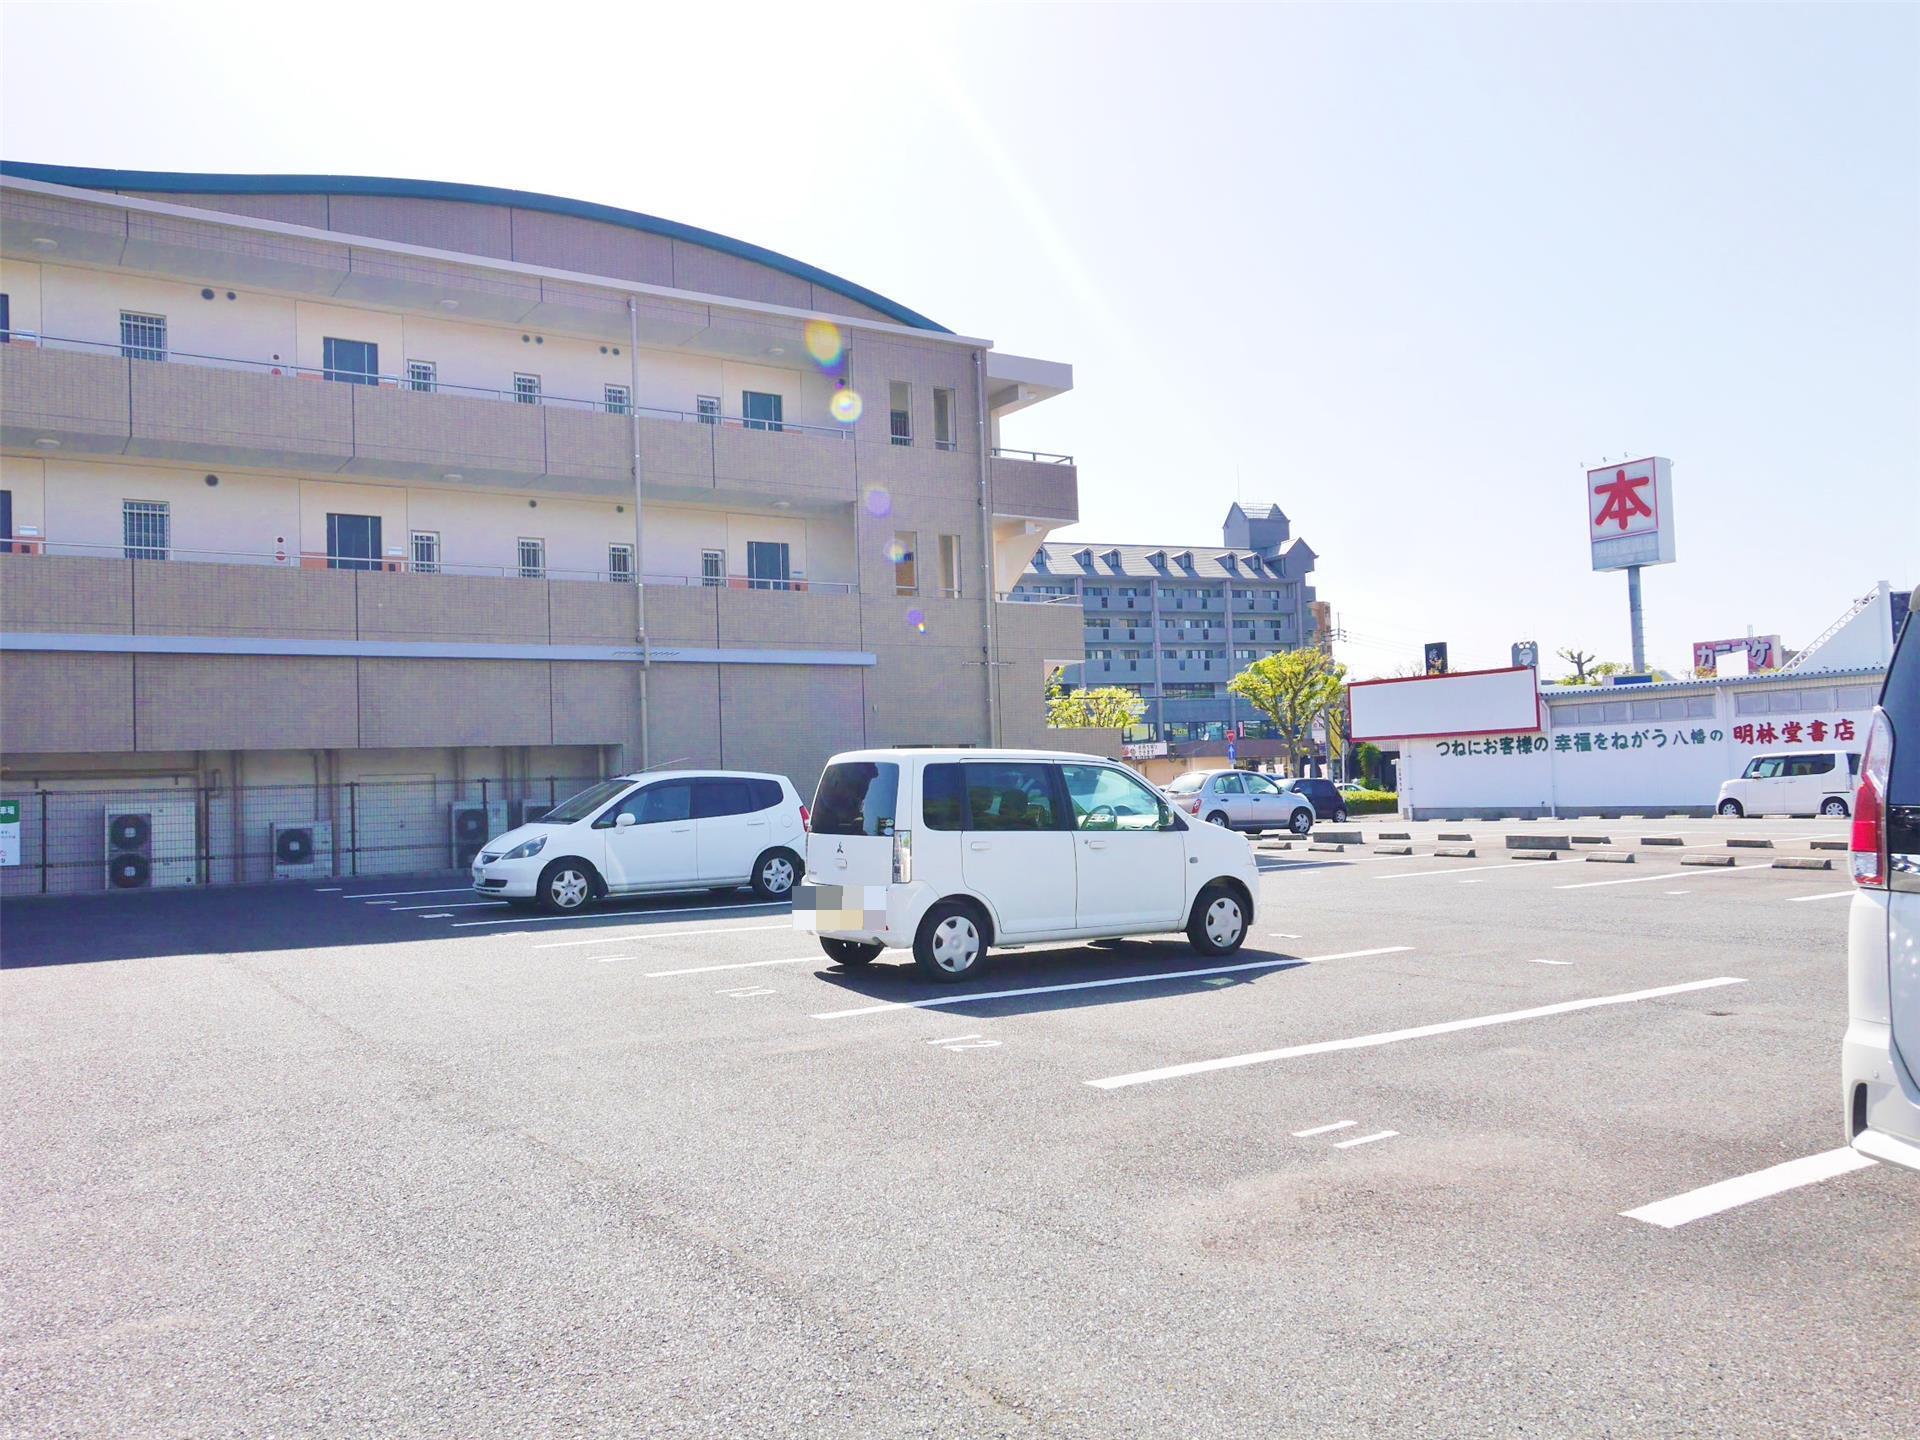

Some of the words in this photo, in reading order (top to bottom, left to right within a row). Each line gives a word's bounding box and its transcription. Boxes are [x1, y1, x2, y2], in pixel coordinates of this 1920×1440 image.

[1594, 469, 1652, 530] 本
[1733, 719, 1856, 745] 明林堂書店
